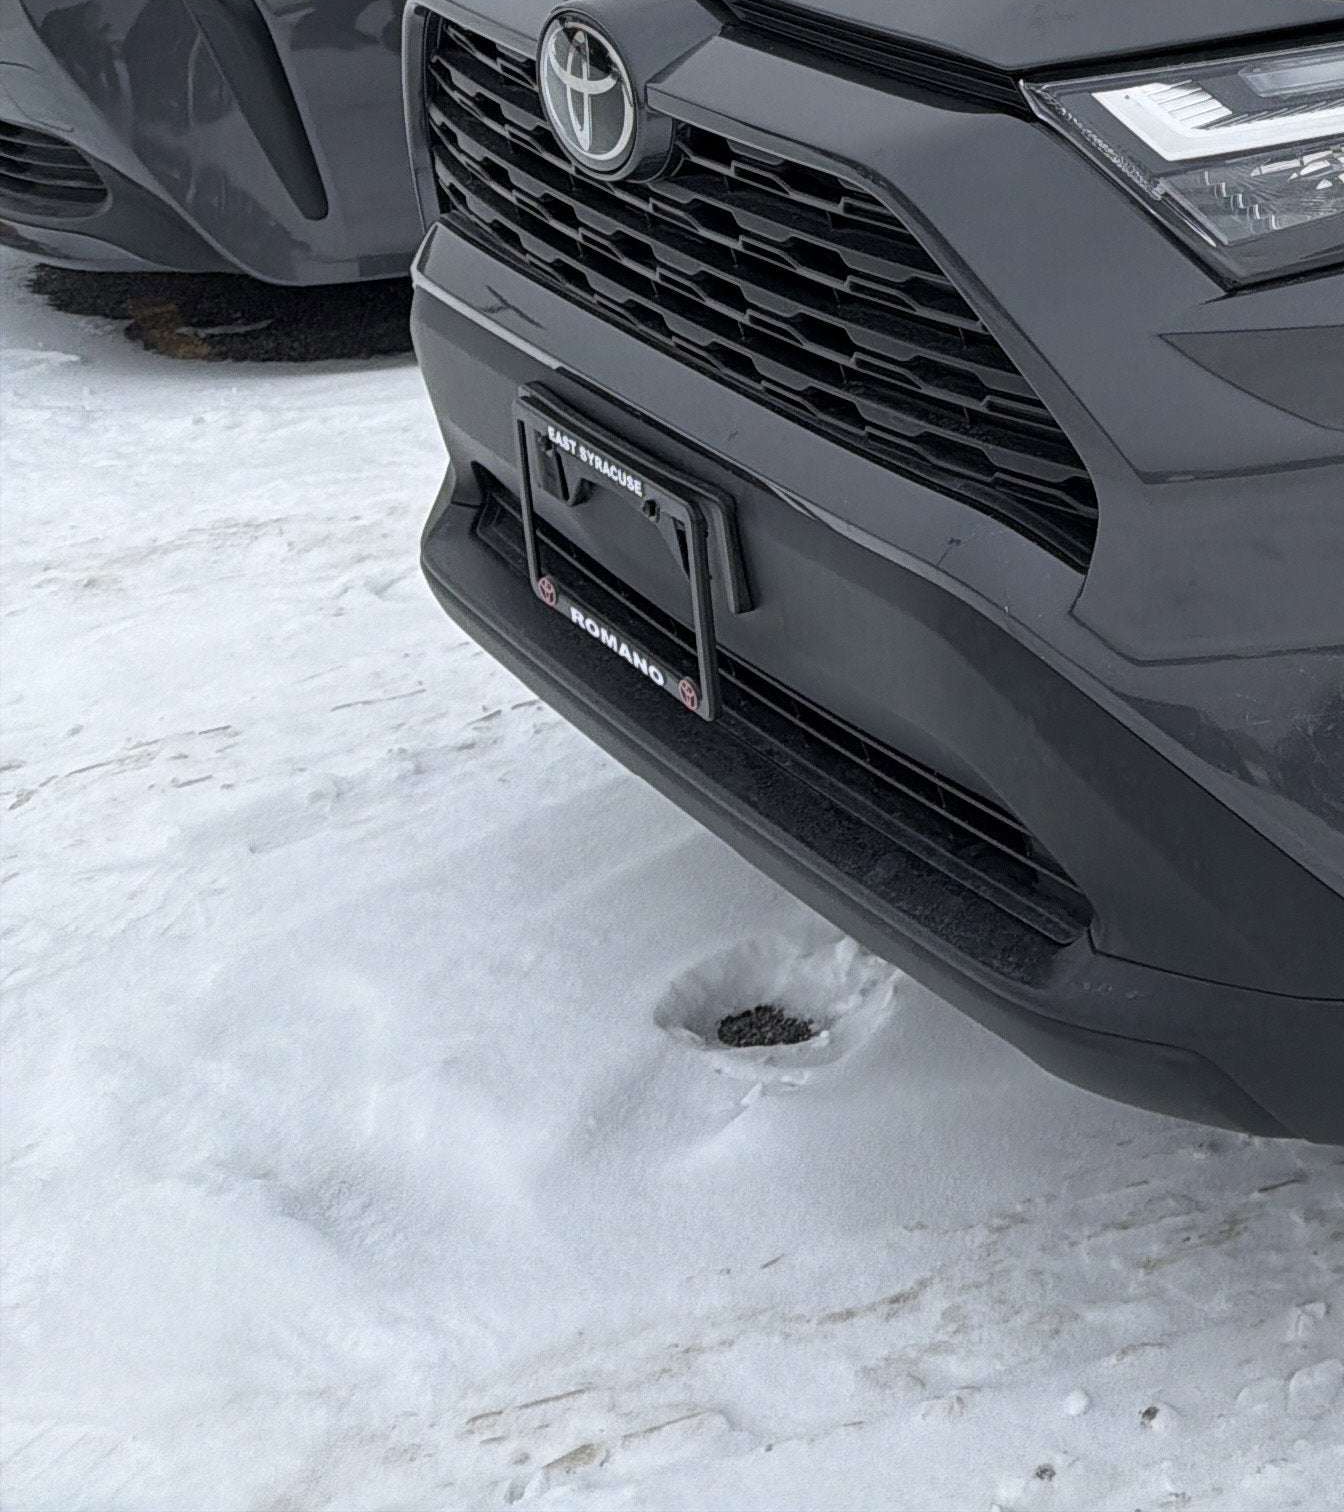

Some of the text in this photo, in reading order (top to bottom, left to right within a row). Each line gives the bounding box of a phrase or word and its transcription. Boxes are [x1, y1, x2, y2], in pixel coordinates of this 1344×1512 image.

[547, 425, 644, 498] EAST SYRACUSE
[570, 606, 665, 687] ROMANO
